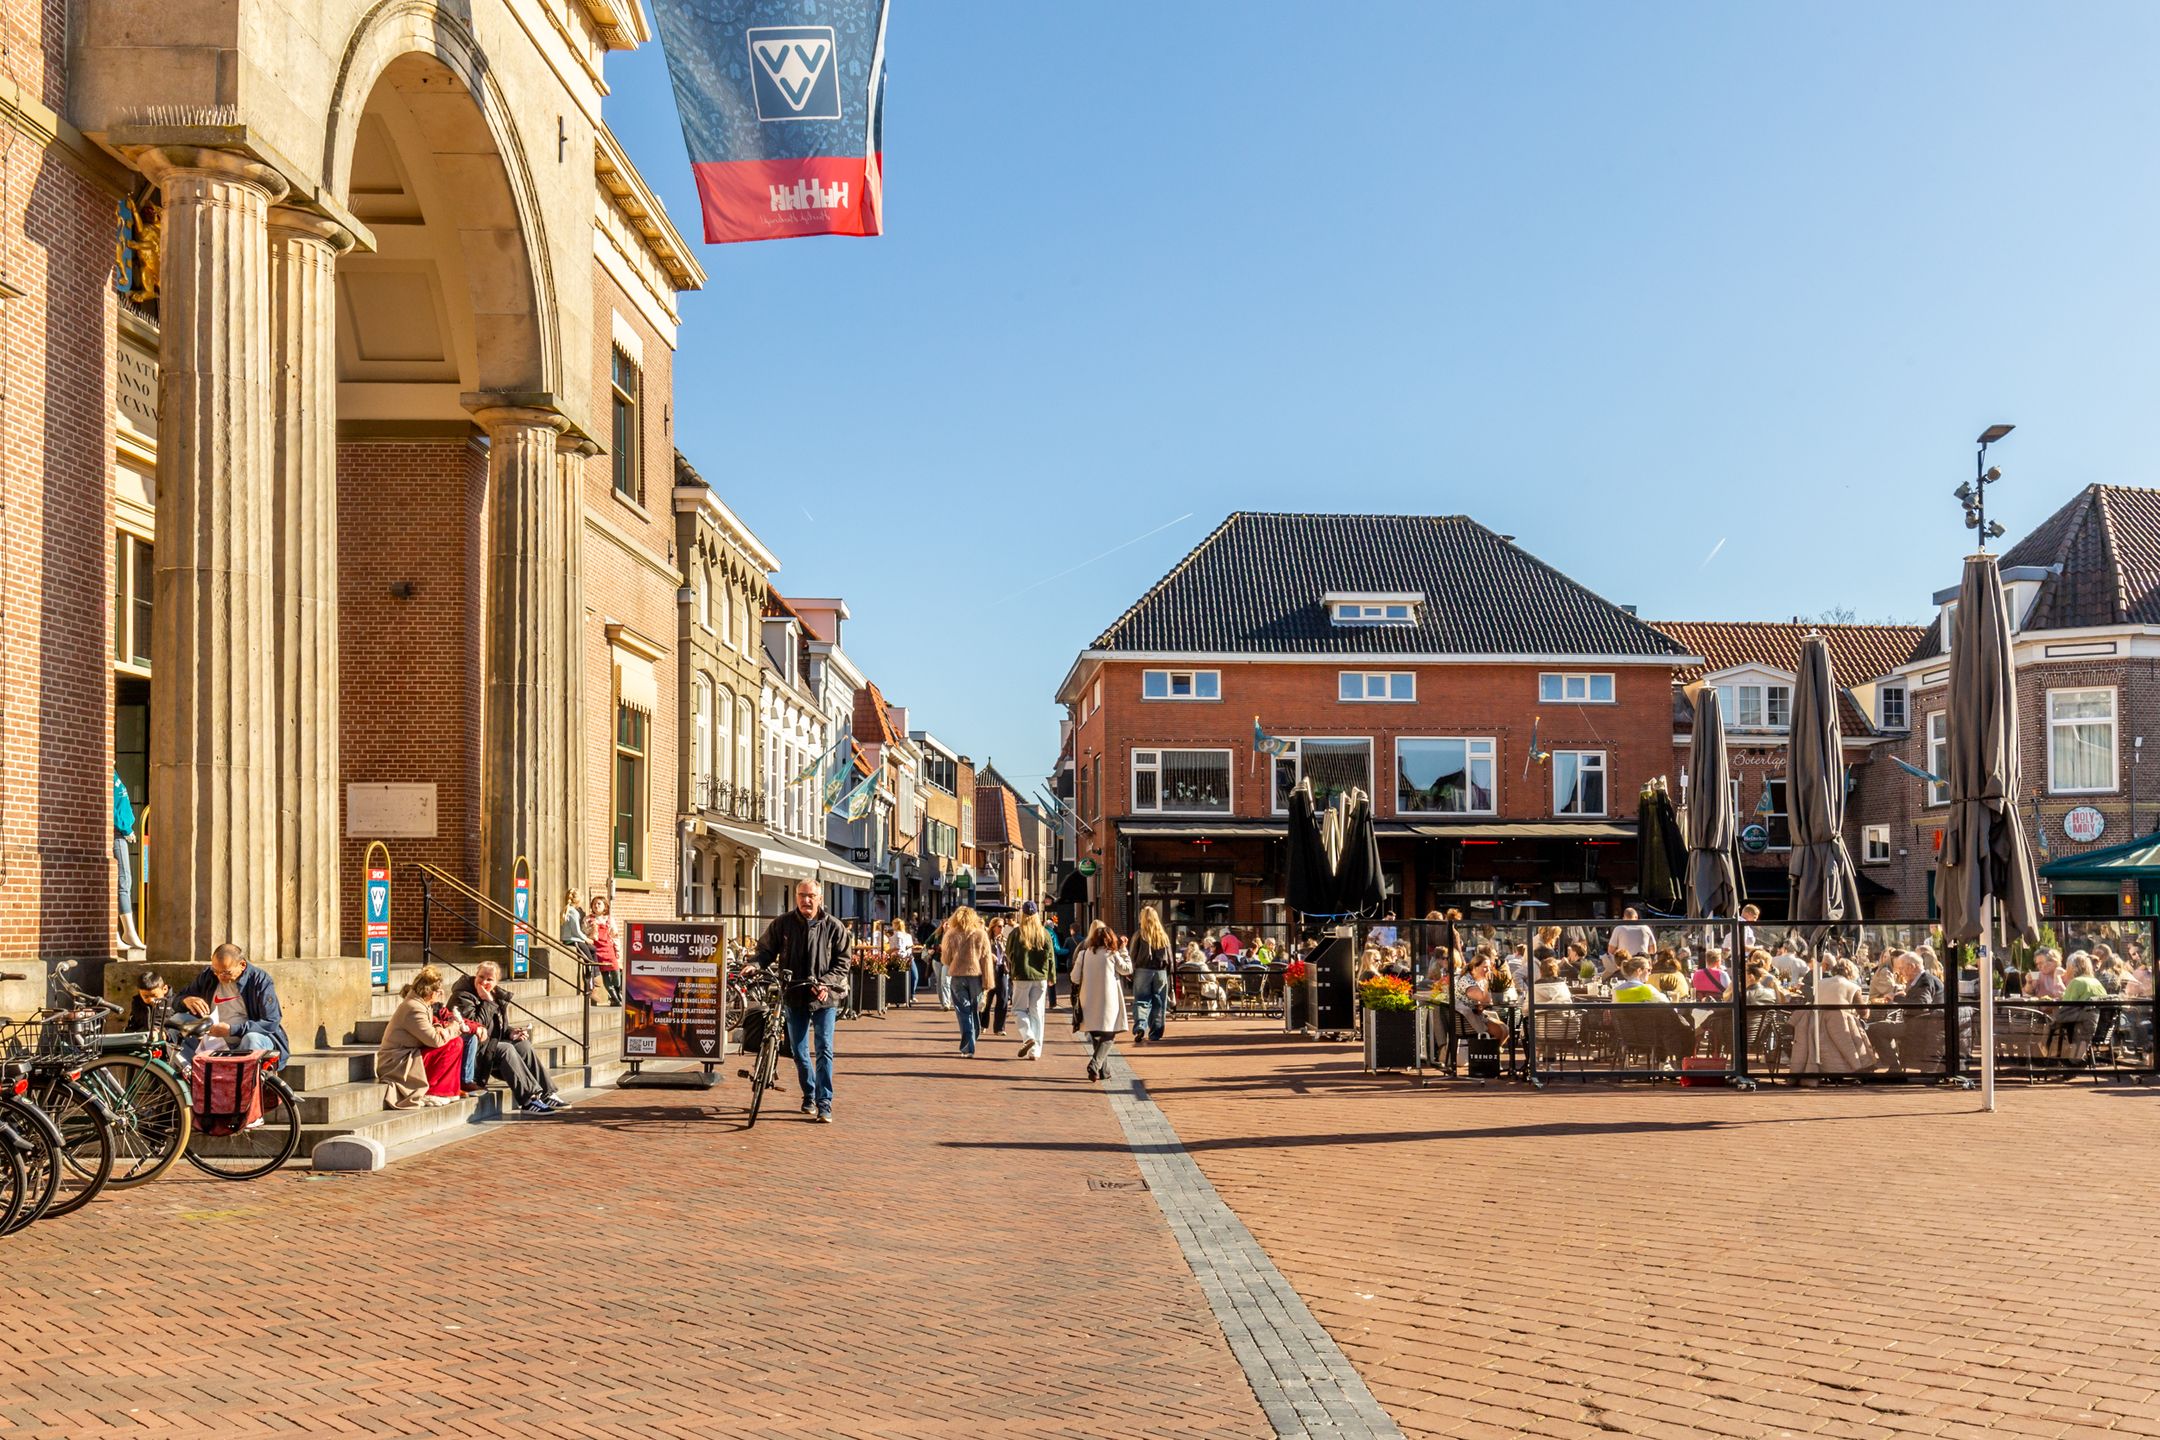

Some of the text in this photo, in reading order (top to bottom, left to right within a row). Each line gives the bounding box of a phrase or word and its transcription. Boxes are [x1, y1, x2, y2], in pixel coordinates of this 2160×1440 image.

[2072, 812, 2095, 823] HOLY
[2072, 823, 2095, 833] MOLY
[647, 933, 691, 943] TOURIST
[693, 934, 718, 944] INFO
[688, 945, 717, 956] SHOP
[660, 965, 715, 974] Informeer binnen
